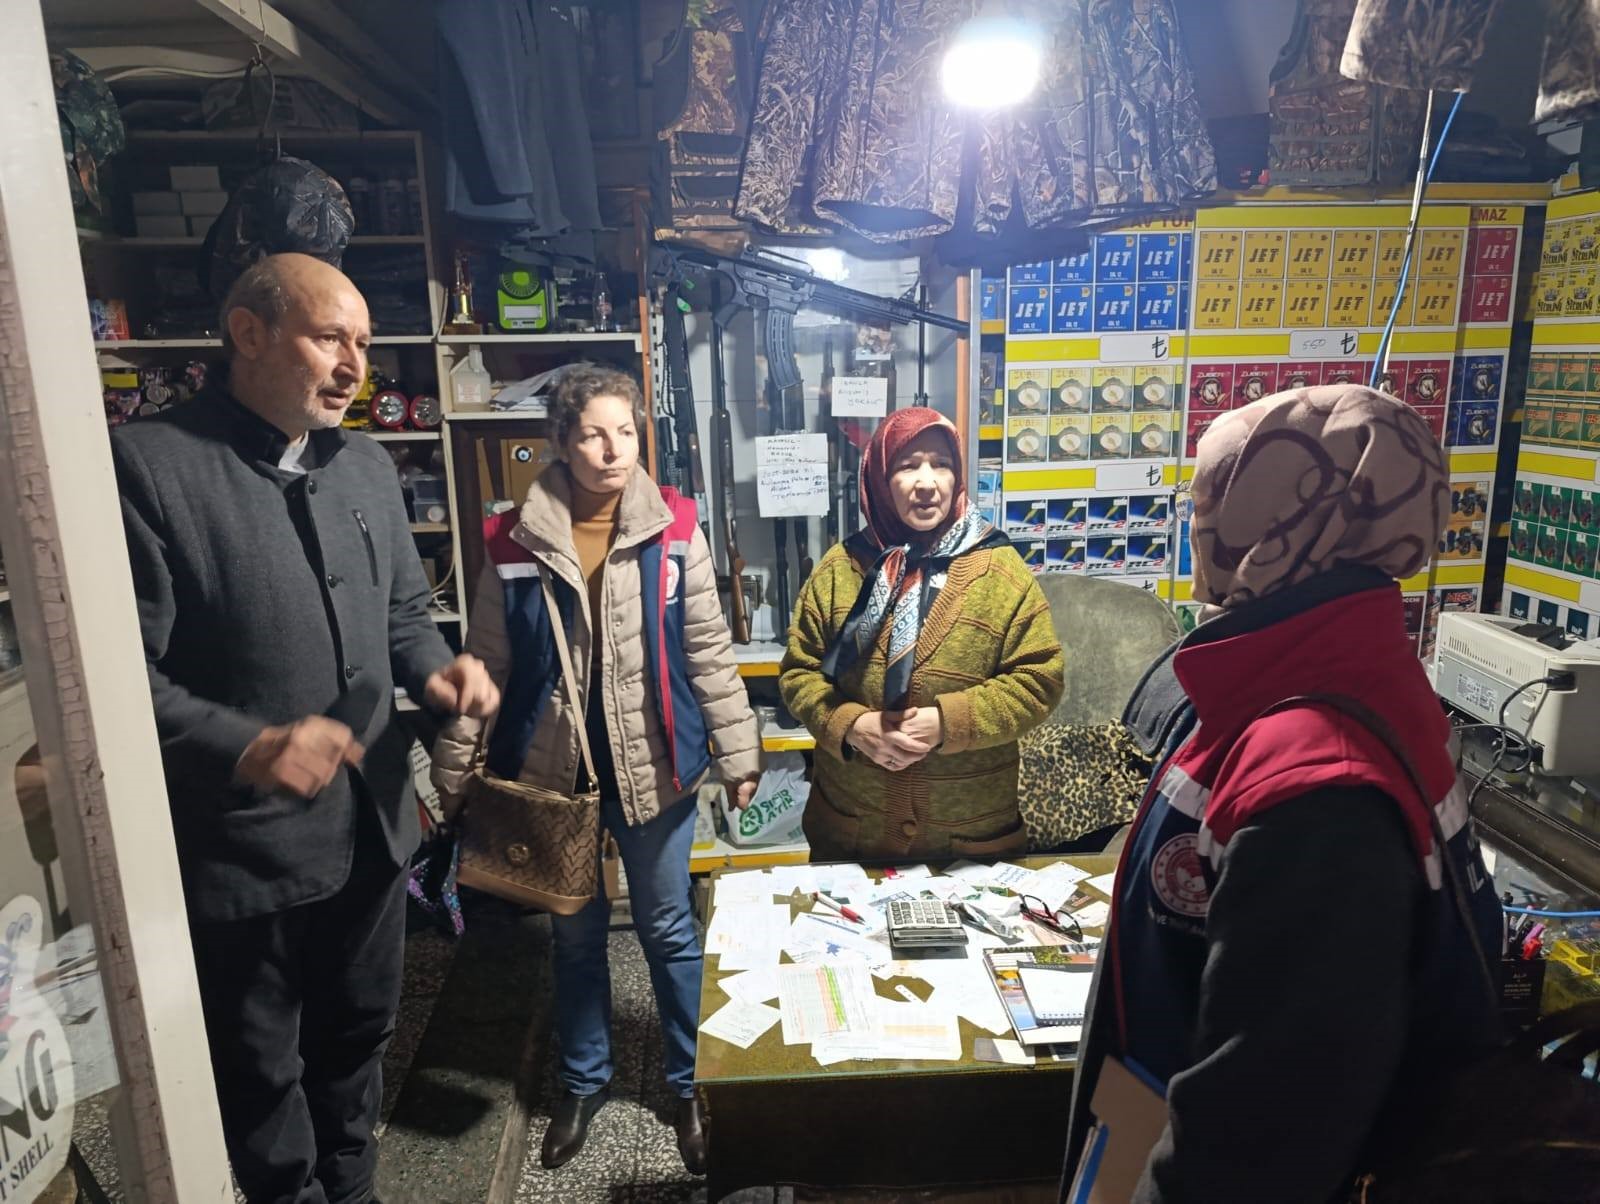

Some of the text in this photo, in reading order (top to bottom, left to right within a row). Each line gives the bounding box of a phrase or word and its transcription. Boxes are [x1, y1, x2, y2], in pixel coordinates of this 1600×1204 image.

[1101, 251, 1131, 266] JET
[1144, 250, 1174, 265] JET
[1204, 248, 1234, 262] JET
[1249, 248, 1279, 262] JET
[1294, 248, 1324, 262] JET
[1338, 247, 1368, 262] JET
[1382, 248, 1401, 260] JE
[1426, 246, 1456, 260] JET
[1482, 245, 1509, 258] JET
[1201, 298, 1231, 312] JET
[1246, 298, 1276, 312] JET
[1290, 297, 1320, 311] JET
[1334, 296, 1364, 310] JET
[1420, 296, 1450, 310] JET
[1477, 292, 1504, 306] JET
[1016, 302, 1044, 318] JET
[1058, 302, 1087, 316] JET
[1100, 301, 1130, 315] JET
[1142, 300, 1172, 314] JET
[10, 1132, 54, 1190] SHELL
